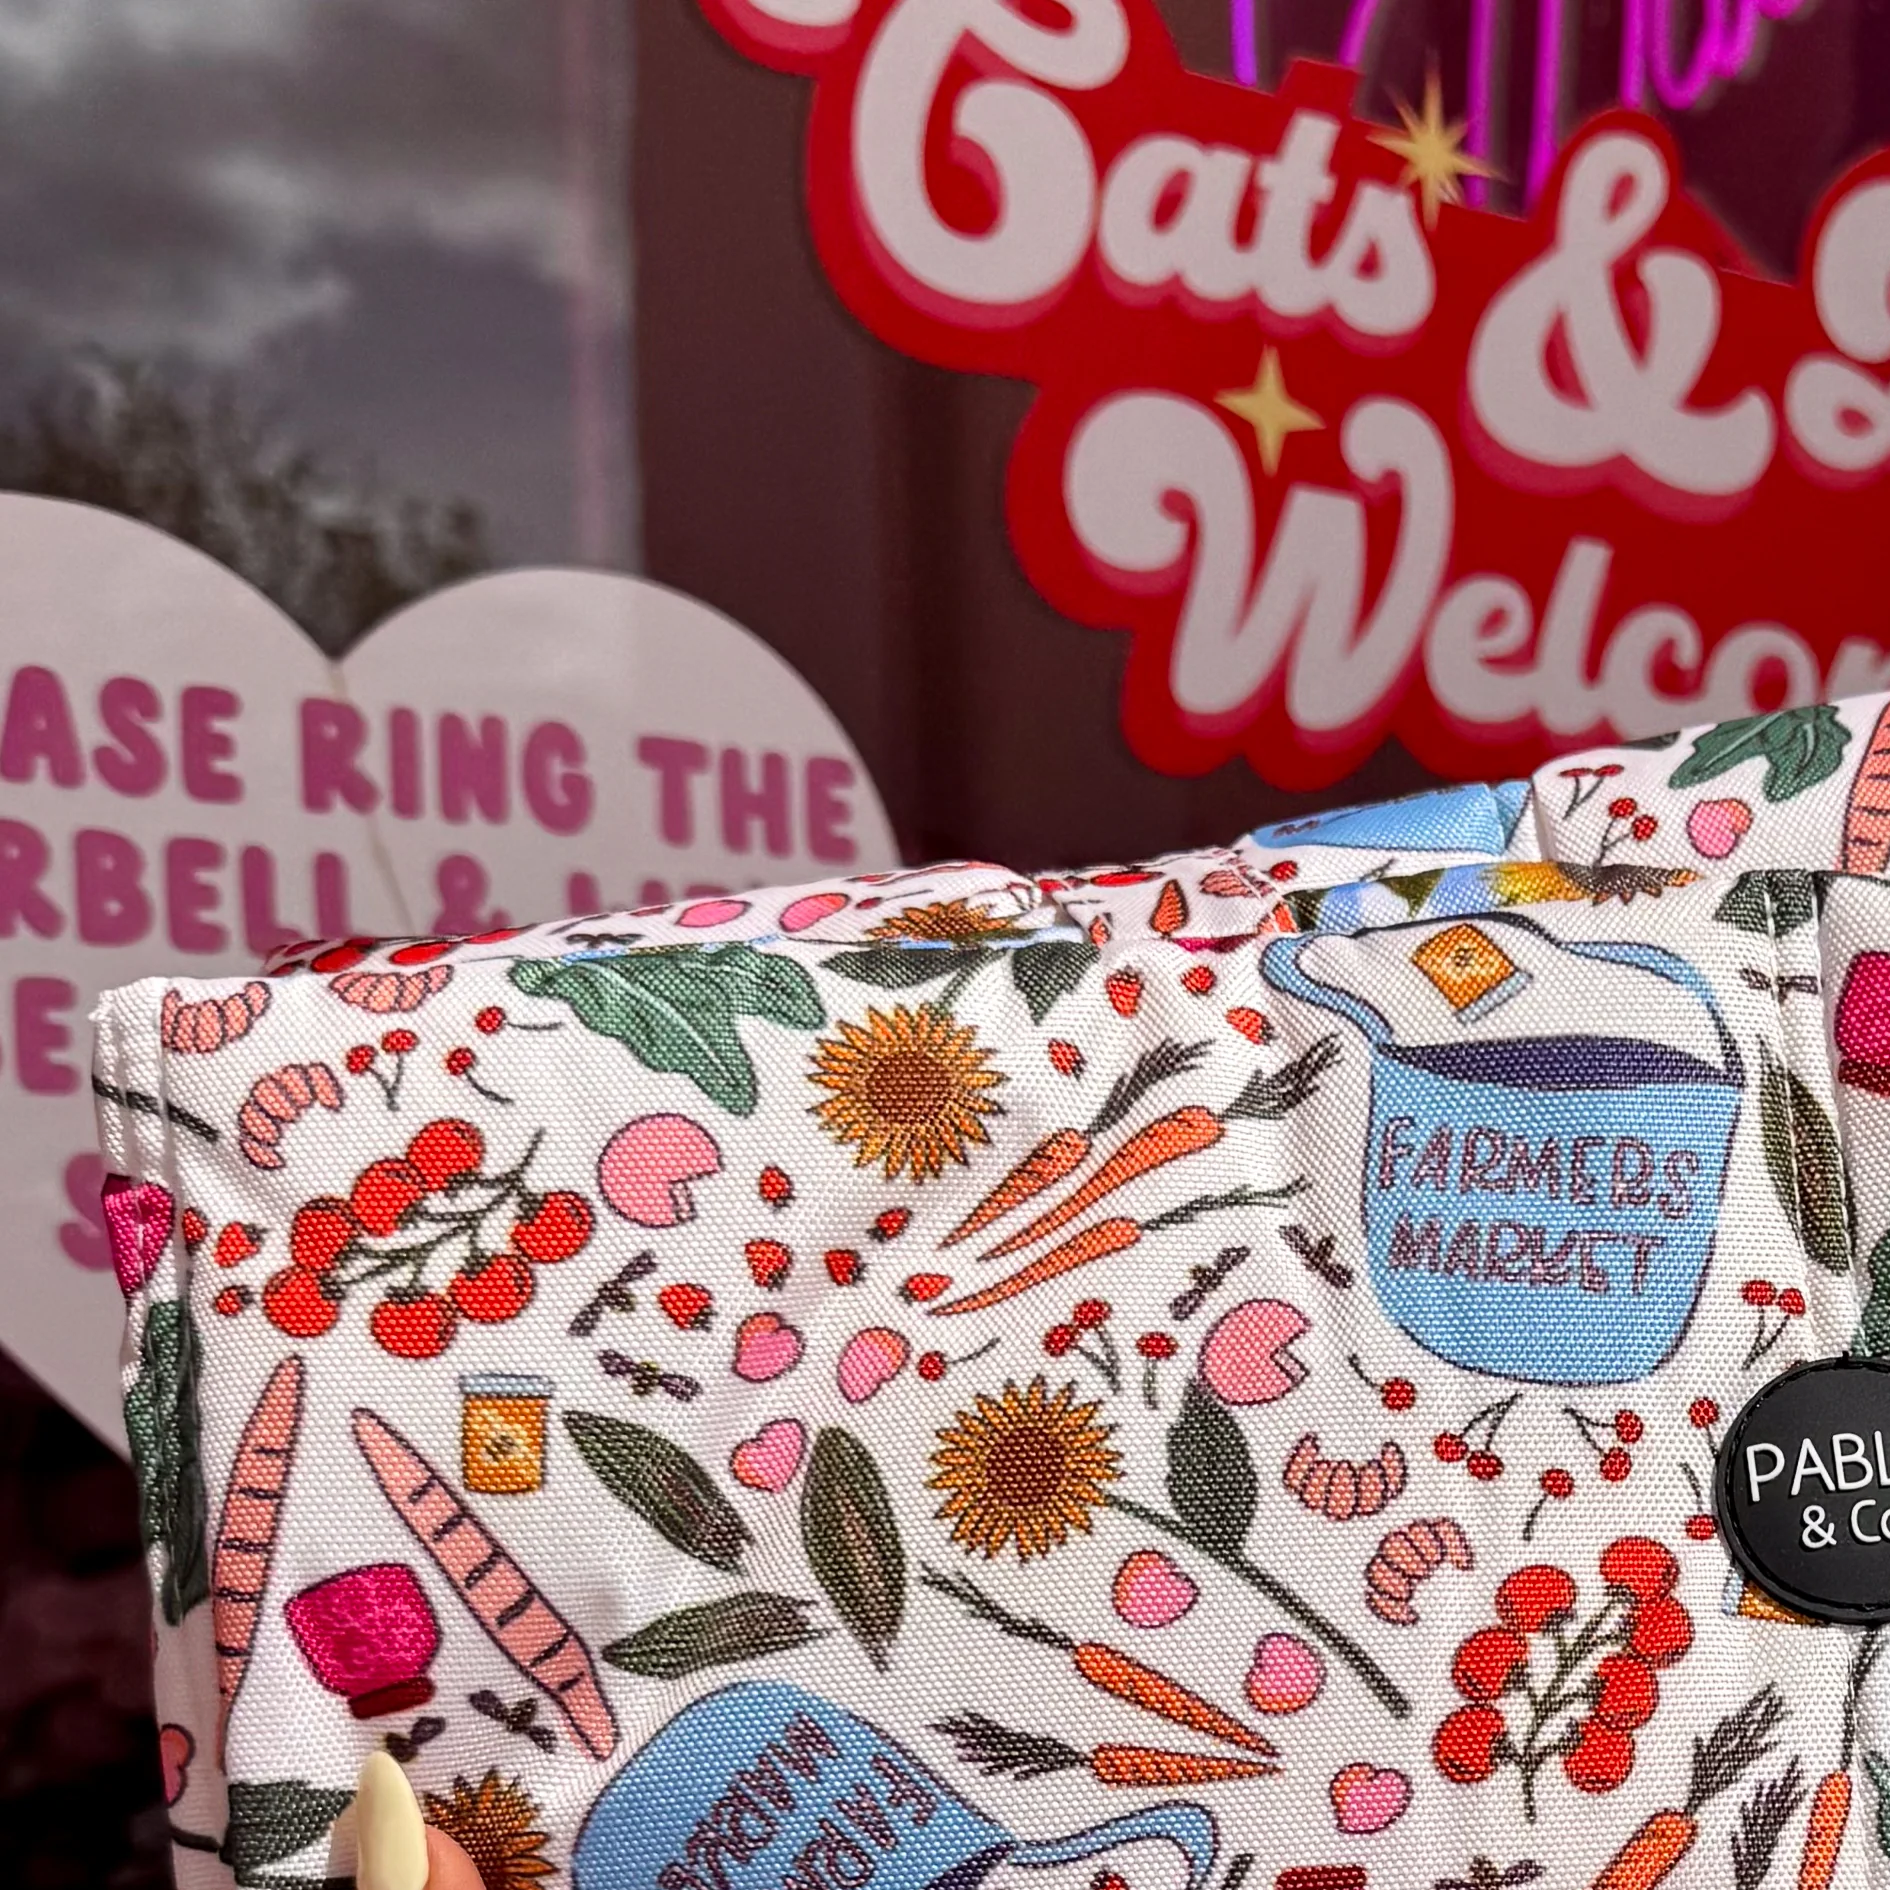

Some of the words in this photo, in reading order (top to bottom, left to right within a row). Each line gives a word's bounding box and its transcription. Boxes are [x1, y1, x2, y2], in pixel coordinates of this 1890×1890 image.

[852, 0, 1436, 337] Cats
[1469, 130, 1775, 496] &
[301, 697, 594, 836] RING
[636, 736, 860, 865] THE
[1378, 1116, 1700, 1219] FARMERS
[1387, 1212, 1666, 1297] MARKET
[1801, 1505, 1838, 1548] &
